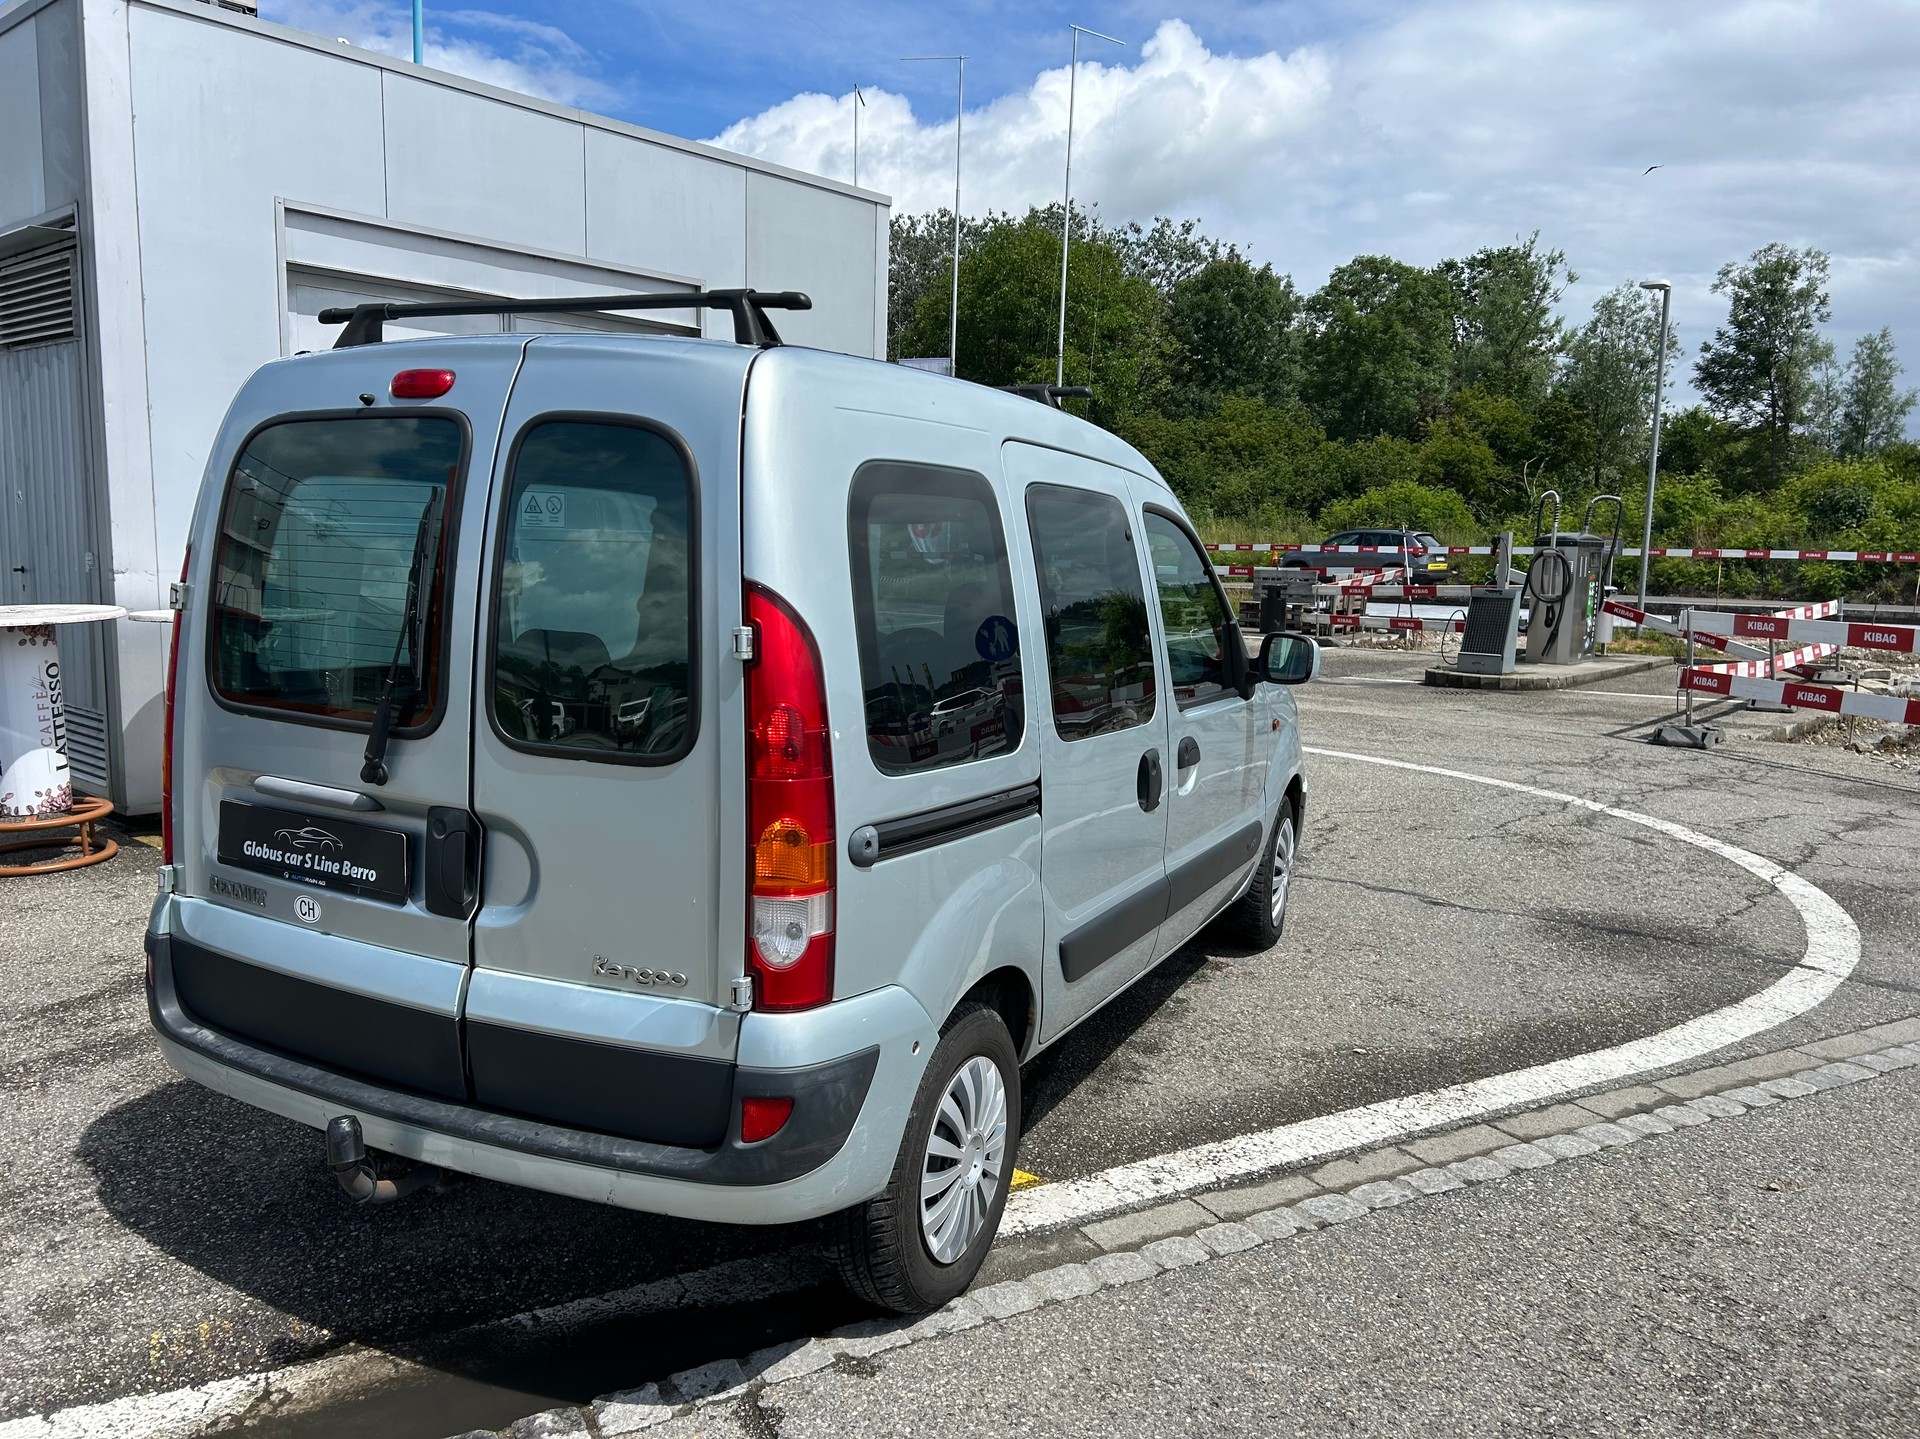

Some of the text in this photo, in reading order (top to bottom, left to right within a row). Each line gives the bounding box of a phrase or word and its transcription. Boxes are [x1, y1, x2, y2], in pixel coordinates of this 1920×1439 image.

[1613, 606, 1634, 619] KIBAG
[1747, 620, 1775, 632] KIBAG
[1864, 631, 1897, 644] KIBAG
[1692, 676, 1718, 688] KIBAG
[1797, 690, 1827, 704] KIBAG
[32, 690, 53, 747] CAFFÈ
[45, 661, 69, 771] LATTESSO
[243, 840, 377, 882] Globus car S Line Berro
[299, 899, 316, 919] CH
[591, 954, 688, 988] Kangoo
